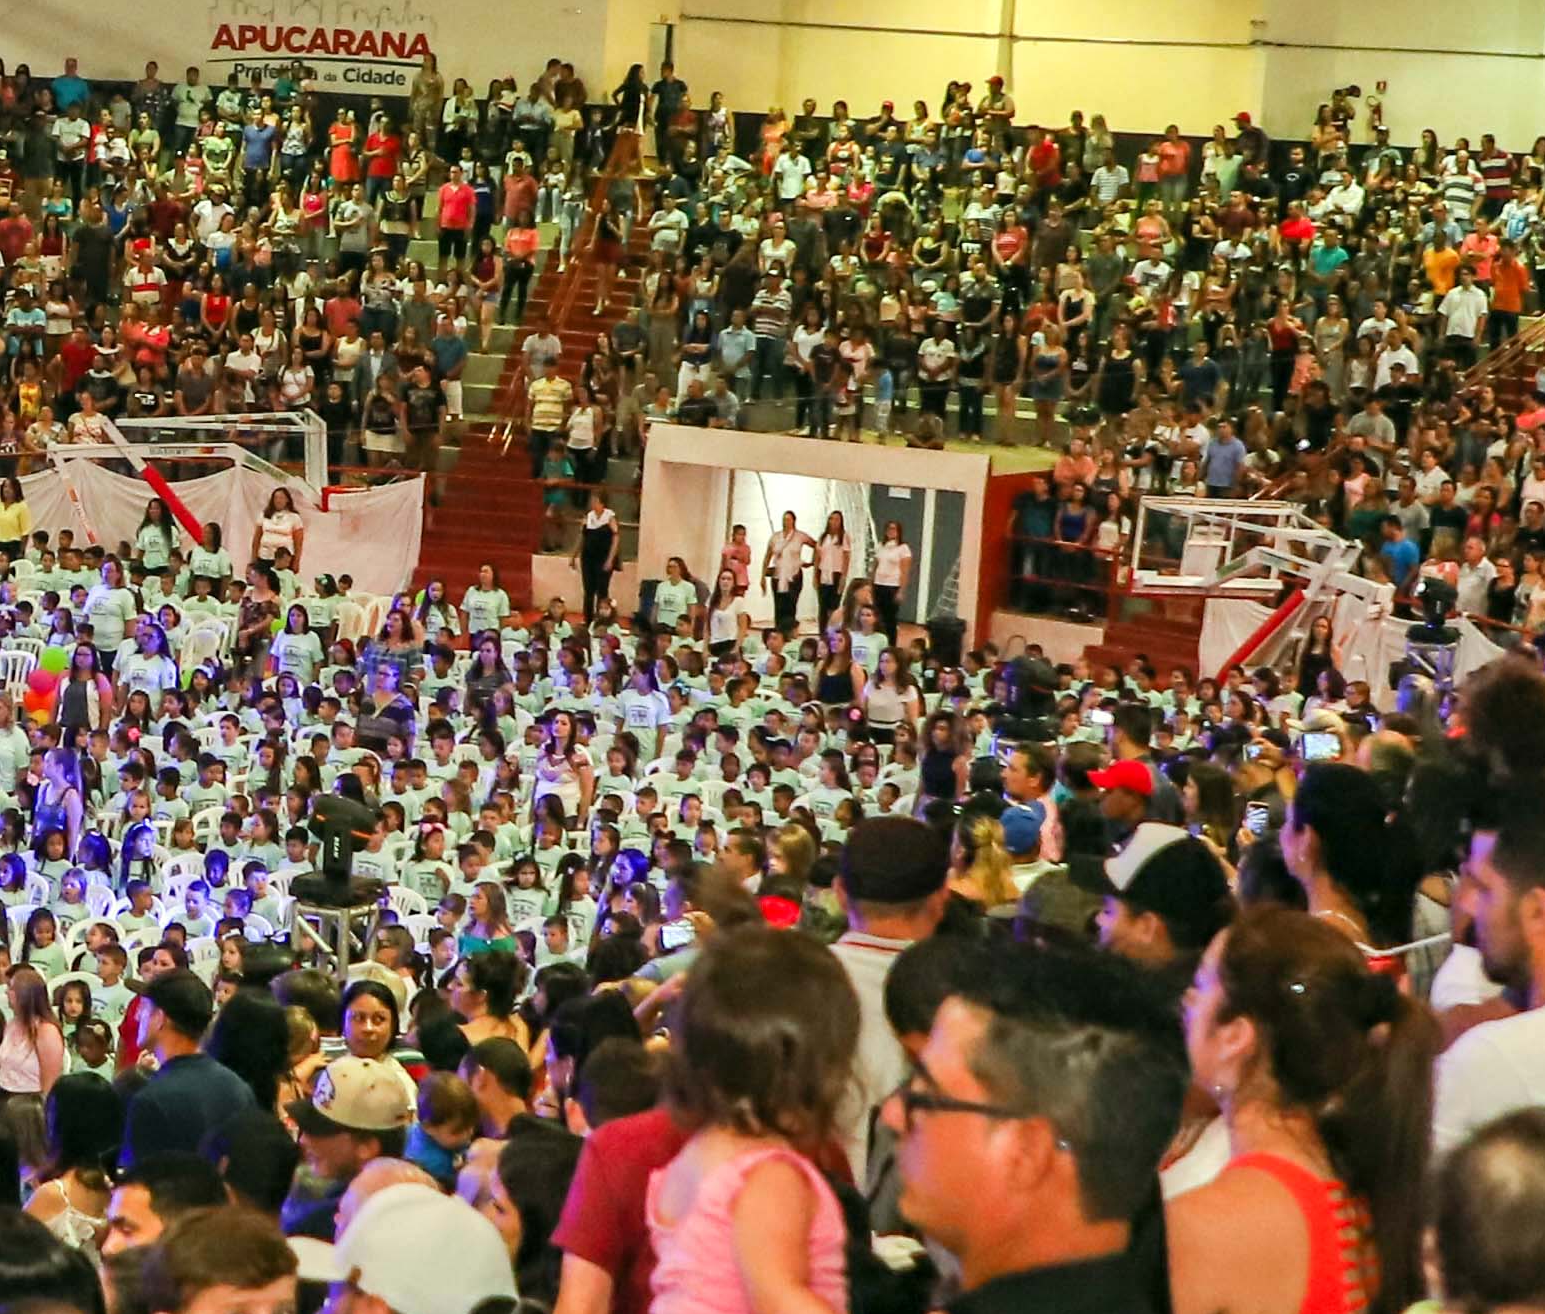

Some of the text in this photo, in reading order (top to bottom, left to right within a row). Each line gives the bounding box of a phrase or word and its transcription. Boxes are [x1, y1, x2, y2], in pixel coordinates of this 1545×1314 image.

[211, 24, 431, 59] APUCARANA
[324, 72, 337, 82] da
[343, 65, 406, 86] Cidade
